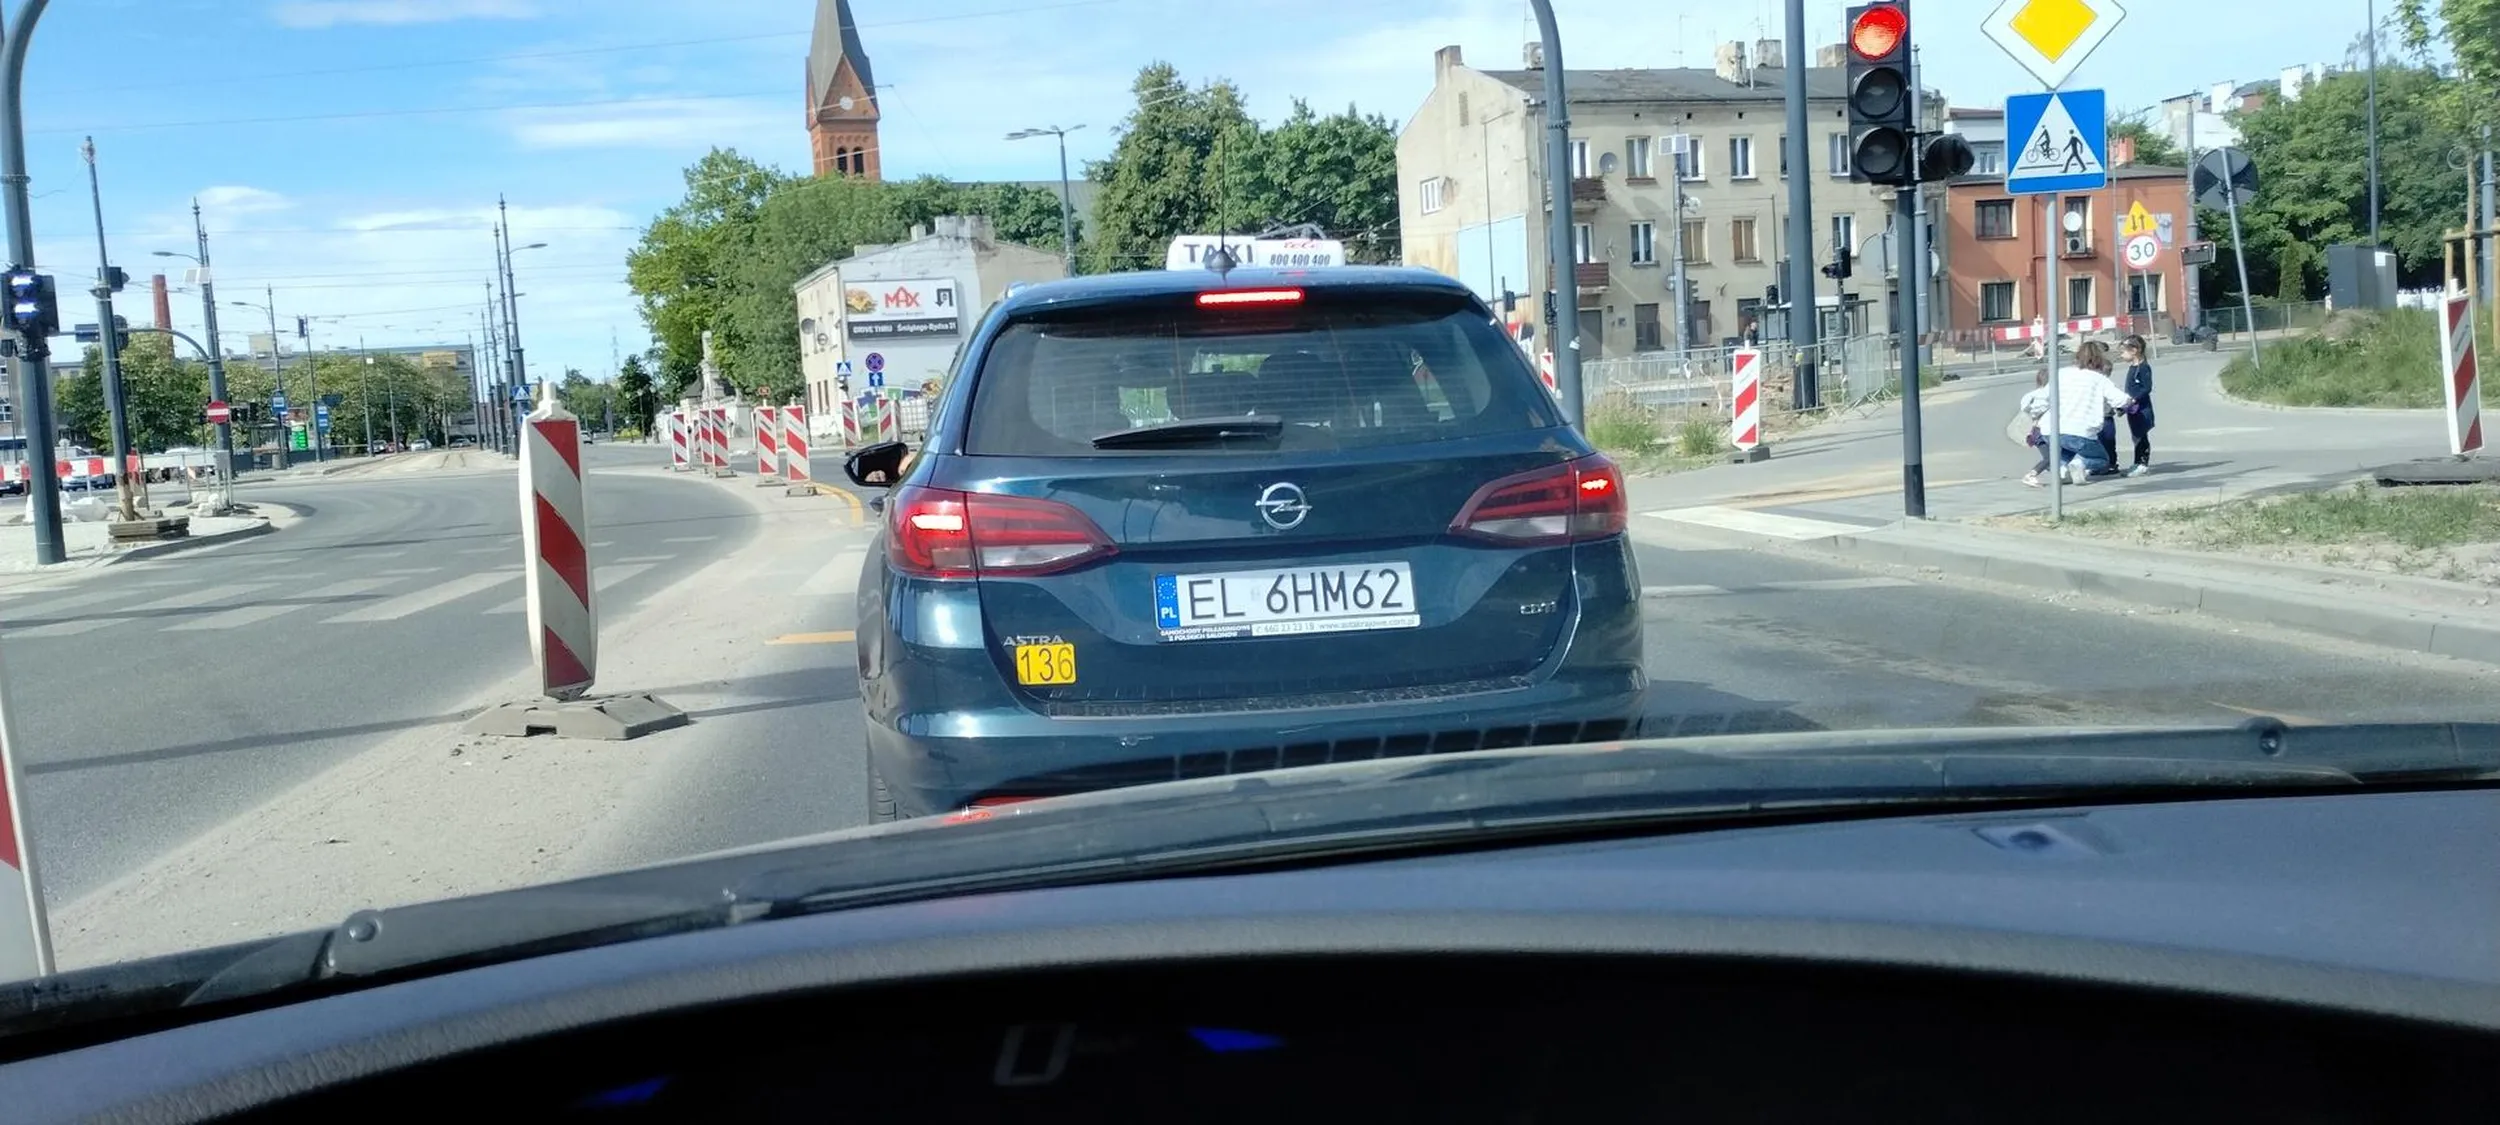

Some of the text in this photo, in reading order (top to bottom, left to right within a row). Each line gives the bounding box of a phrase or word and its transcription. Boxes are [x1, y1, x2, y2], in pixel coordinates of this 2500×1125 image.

[1183, 243, 1254, 264] TAXI
[1270, 253, 1331, 267] 800 400 400
[2130, 241, 2156, 262] 30
[884, 286, 920, 308] MAX
[1188, 568, 1403, 620] EL 6HM62
[1161, 607, 1177, 619] PL
[1003, 635, 1064, 647] ASTRA
[1021, 646, 1073, 683] 136
